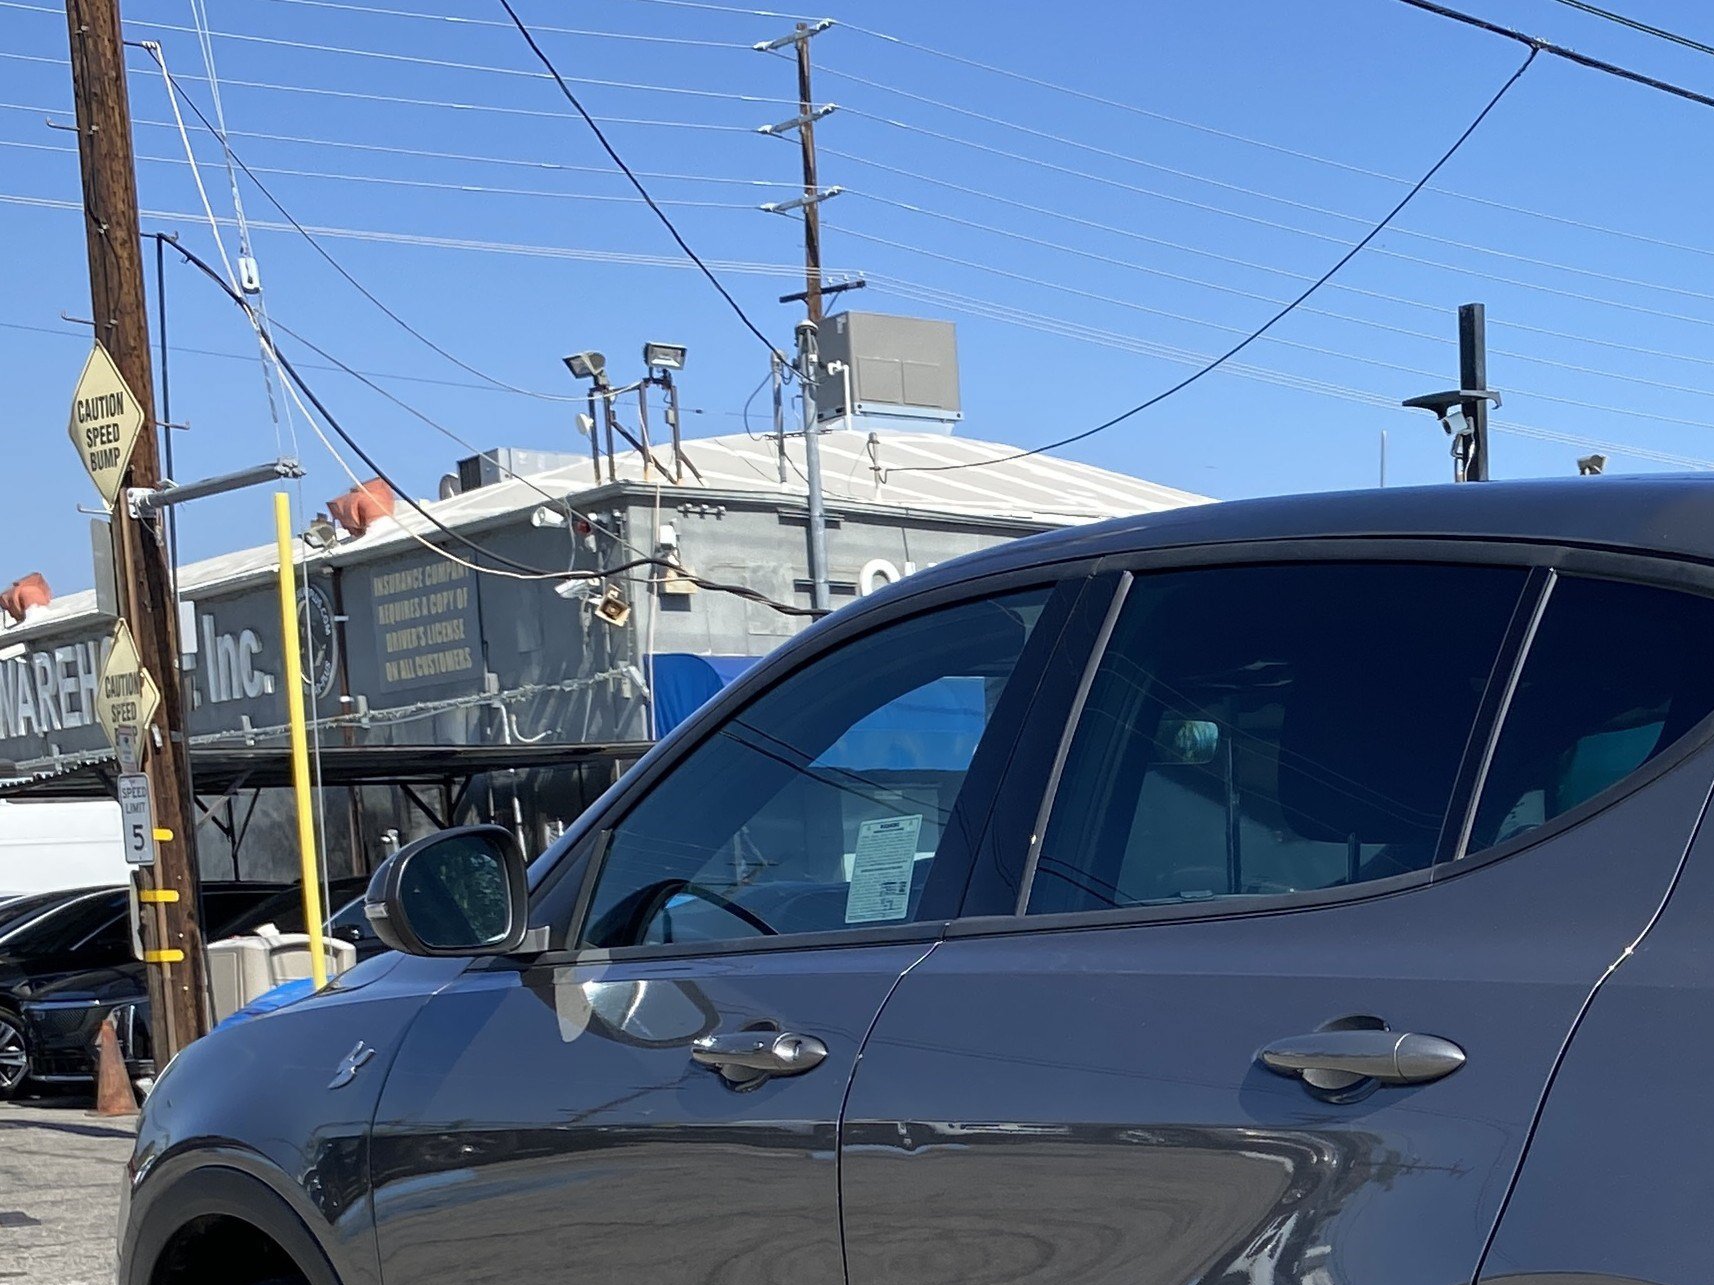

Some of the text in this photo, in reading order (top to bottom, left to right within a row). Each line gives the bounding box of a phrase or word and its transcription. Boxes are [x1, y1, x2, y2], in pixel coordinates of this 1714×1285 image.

[77, 391, 125, 424] CAUTION
[86, 423, 120, 449] SPEED
[90, 447, 121, 472] BUMP
[374, 567, 423, 597] INSURANCE
[378, 587, 468, 625] REQUIRES A COPY OF
[385, 618, 466, 653] DRIVER'S LICENSE
[202, 614, 275, 703] Inc.
[385, 646, 472, 682] ON ALL CUSTOMERS
[105, 671, 141, 699] CAUTION
[111, 701, 137, 724] SPEED
[121, 786, 147, 799] SPEED
[125, 802, 146, 815] LIMIT
[132, 824, 145, 851] 5
